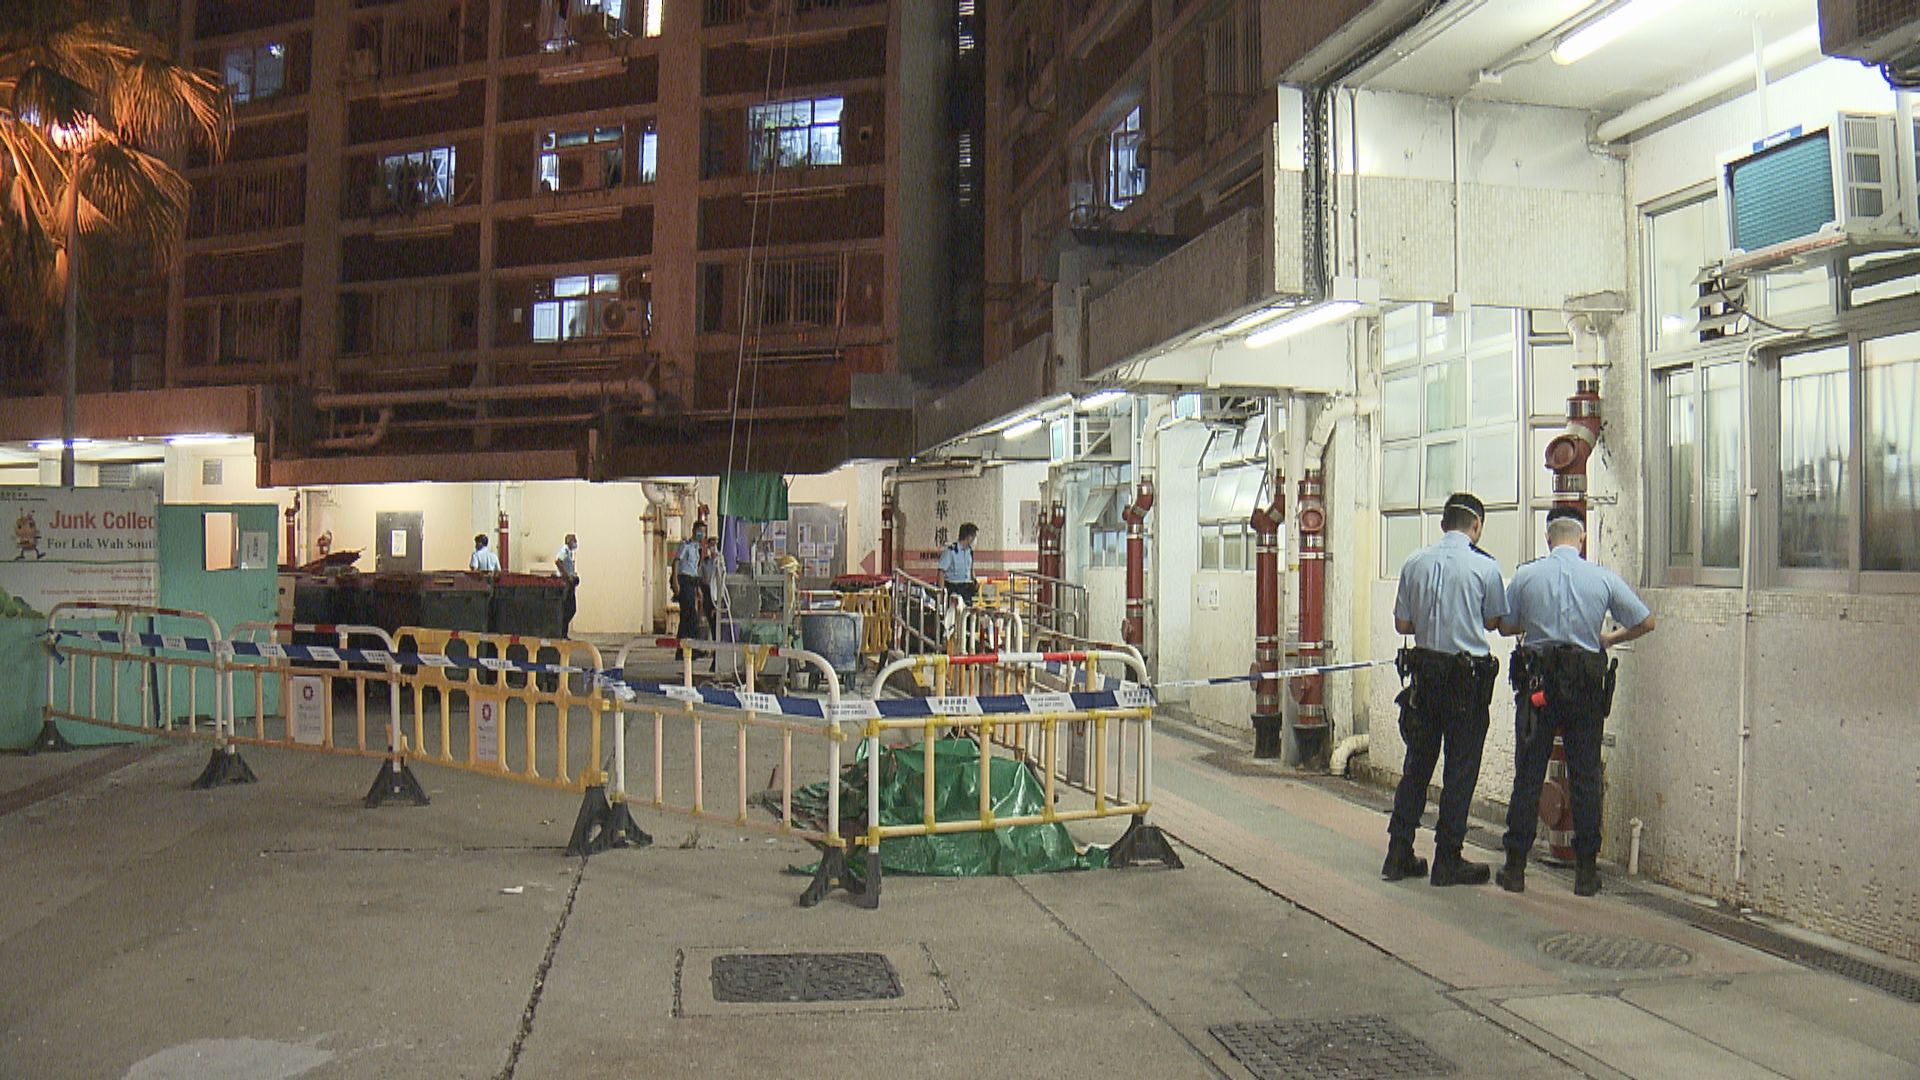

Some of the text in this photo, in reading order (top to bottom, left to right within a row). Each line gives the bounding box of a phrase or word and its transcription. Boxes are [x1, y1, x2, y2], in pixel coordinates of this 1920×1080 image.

[49, 510, 97, 529] Junk
[47, 538, 67, 549] For
[71, 538, 94, 549] Lok
[97, 538, 124, 549] Wah
